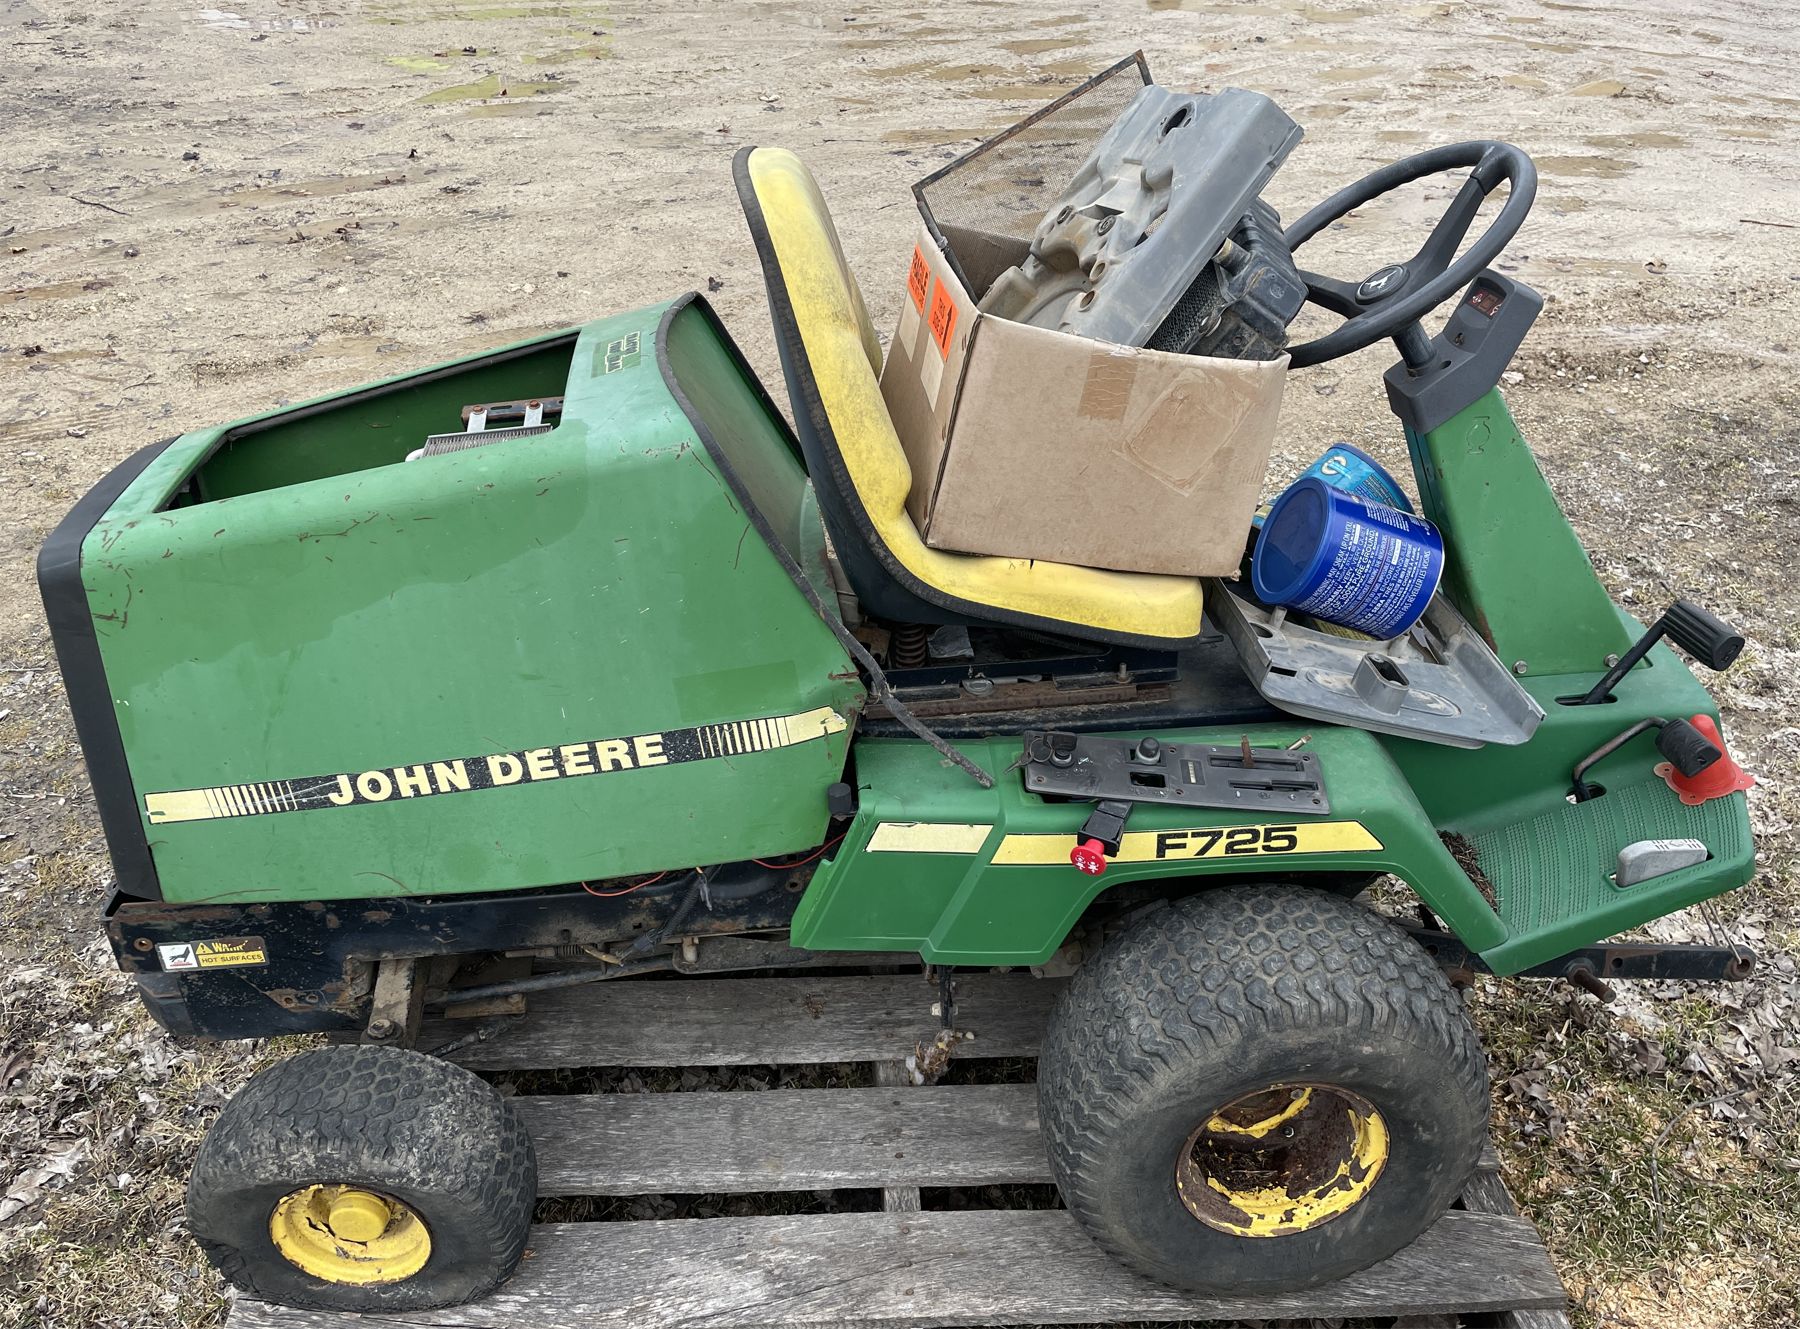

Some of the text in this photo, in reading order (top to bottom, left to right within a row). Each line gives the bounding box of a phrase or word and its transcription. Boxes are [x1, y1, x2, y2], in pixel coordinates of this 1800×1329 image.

[1318, 584, 1343, 609] PROBABLY
[1351, 546, 1361, 565] VERY
[1326, 566, 1337, 578] MAY
[1332, 549, 1346, 567] SNEAK
[1379, 565, 1395, 591] ENCORE
[1339, 584, 1355, 601] 100%
[1351, 563, 1365, 584] PURE
[1370, 598, 1385, 613] SERA
[328, 734, 668, 805] JOHN DEERE
[1156, 826, 1297, 858] F725
[220, 954, 262, 962] SURFACES
